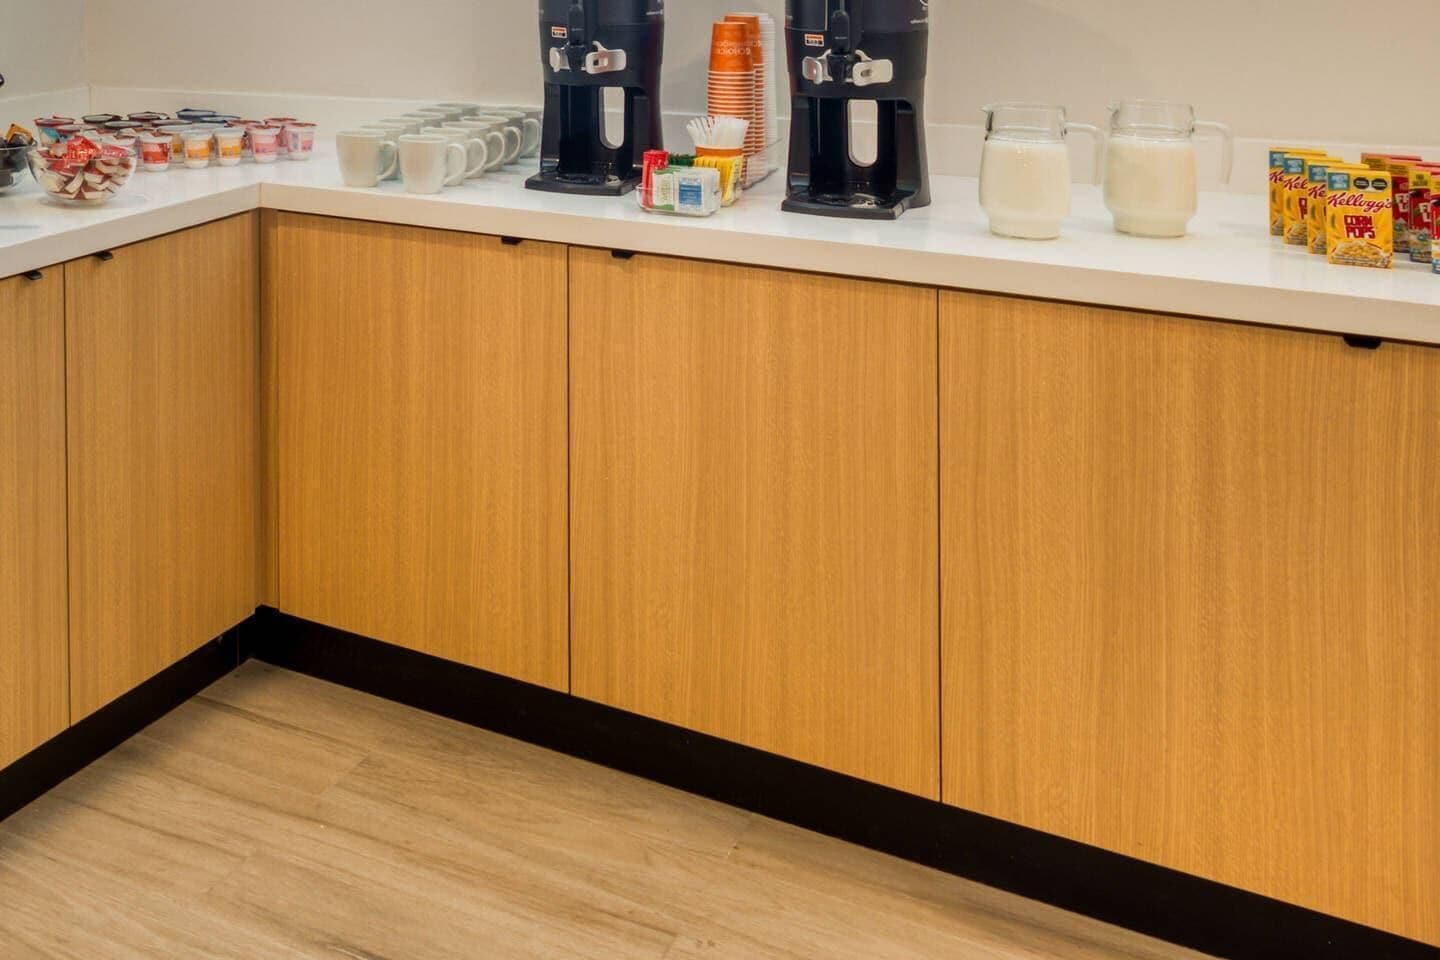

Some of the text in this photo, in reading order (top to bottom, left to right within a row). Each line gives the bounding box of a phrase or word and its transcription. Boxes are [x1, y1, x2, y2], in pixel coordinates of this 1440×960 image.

[1327, 192, 1392, 213] Kellogg's
[1344, 214, 1373, 227] CORN
[1345, 226, 1376, 240] POPS
